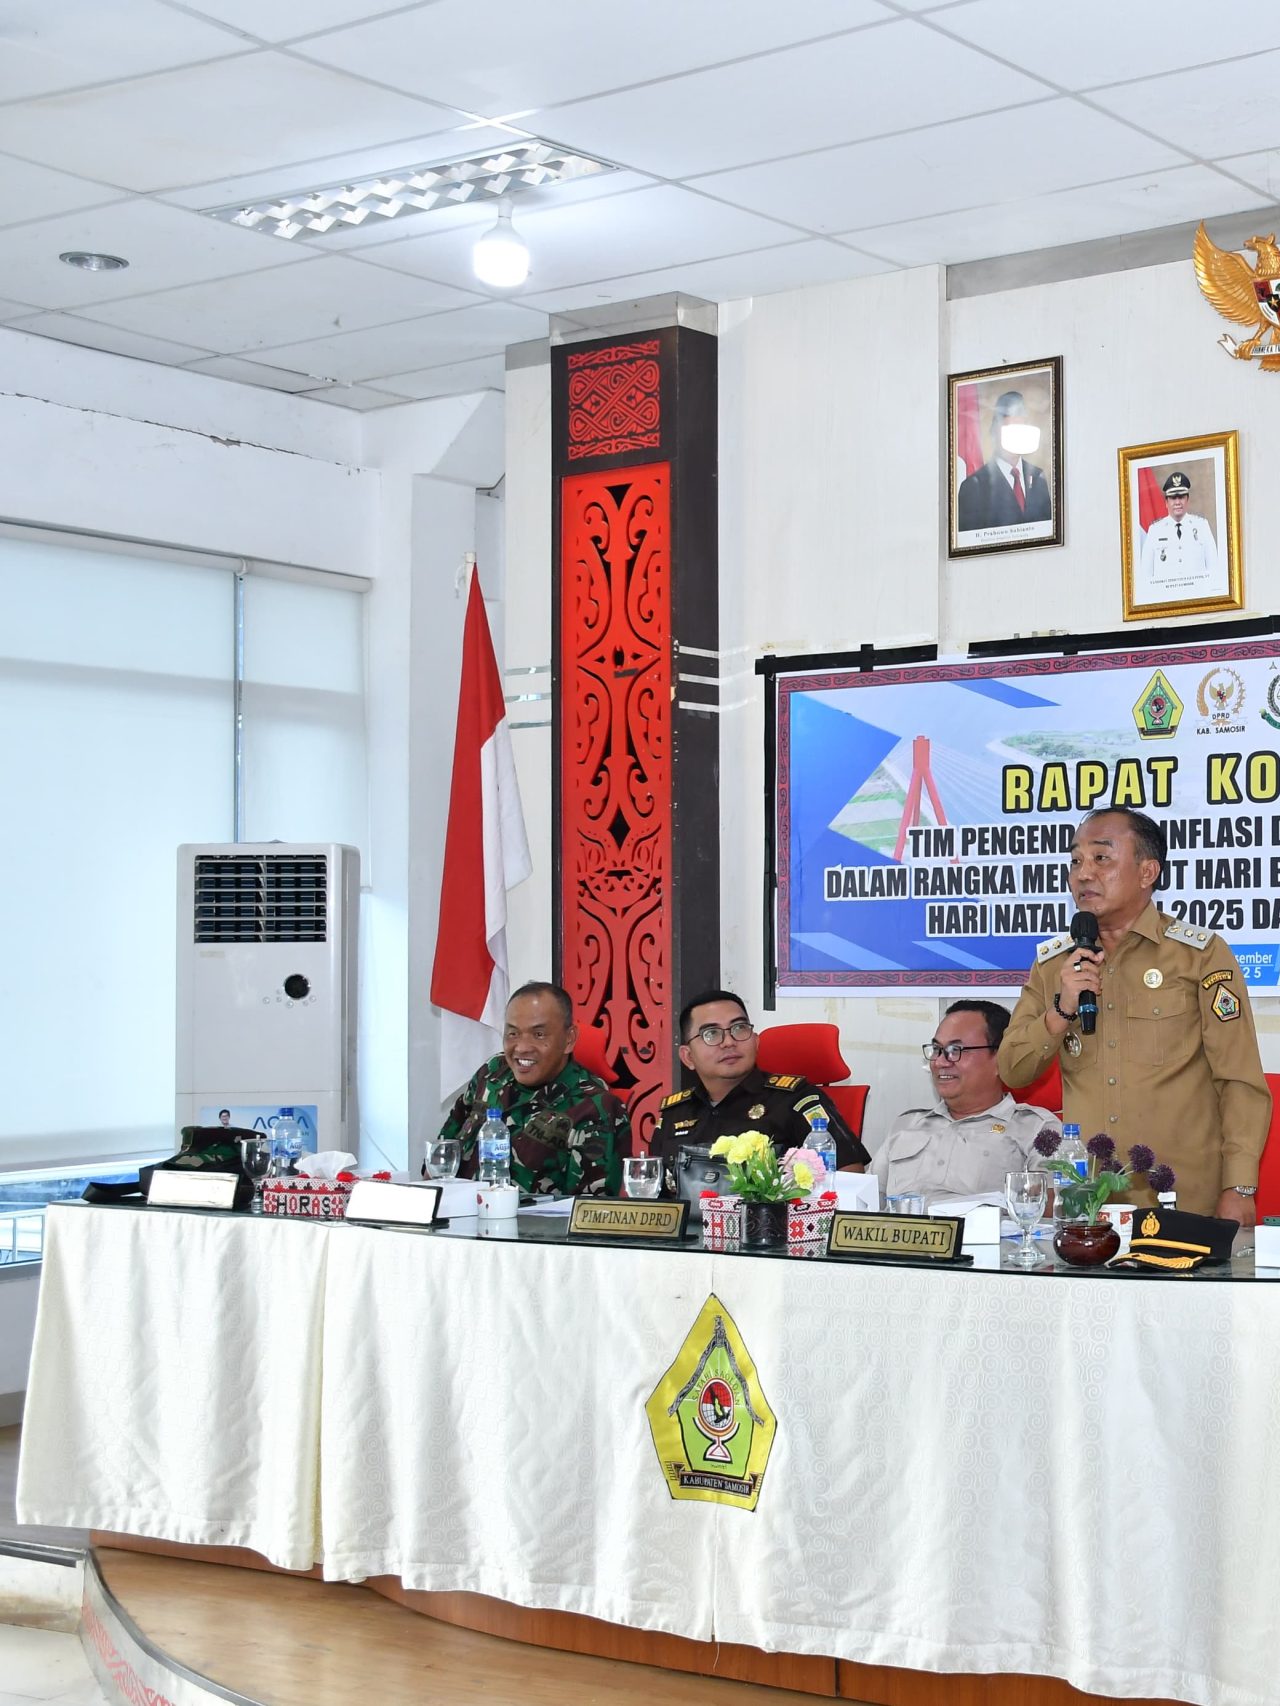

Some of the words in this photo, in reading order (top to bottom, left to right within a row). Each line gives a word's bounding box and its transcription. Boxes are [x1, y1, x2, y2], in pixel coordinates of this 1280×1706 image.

[1211, 712, 1230, 720] DPRD
[1215, 725, 1246, 734] SAMOSIR
[1002, 756, 1178, 813] RAPAT
[908, 827, 956, 858] TIM
[965, 823, 1073, 857] PENGEND
[1159, 815, 1263, 850] INFLASI
[825, 868, 907, 899] DALAM
[913, 864, 1016, 897] RANGKA
[1194, 856, 1262, 890] HARI
[927, 903, 987, 935] HARI
[993, 902, 1070, 934] NATAL
[1171, 898, 1245, 931] 2025
[1235, 952, 1273, 965] sember
[275, 1194, 332, 1216] HORAS
[581, 1209, 639, 1225] PIMPINAN
[640, 1211, 673, 1227] DPRD
[843, 1225, 889, 1243] WAKIL
[891, 1228, 946, 1246] BUPATI
[683, 1475, 723, 1489] KABUPATEN
[724, 1480, 751, 1494] SAMOSIR
